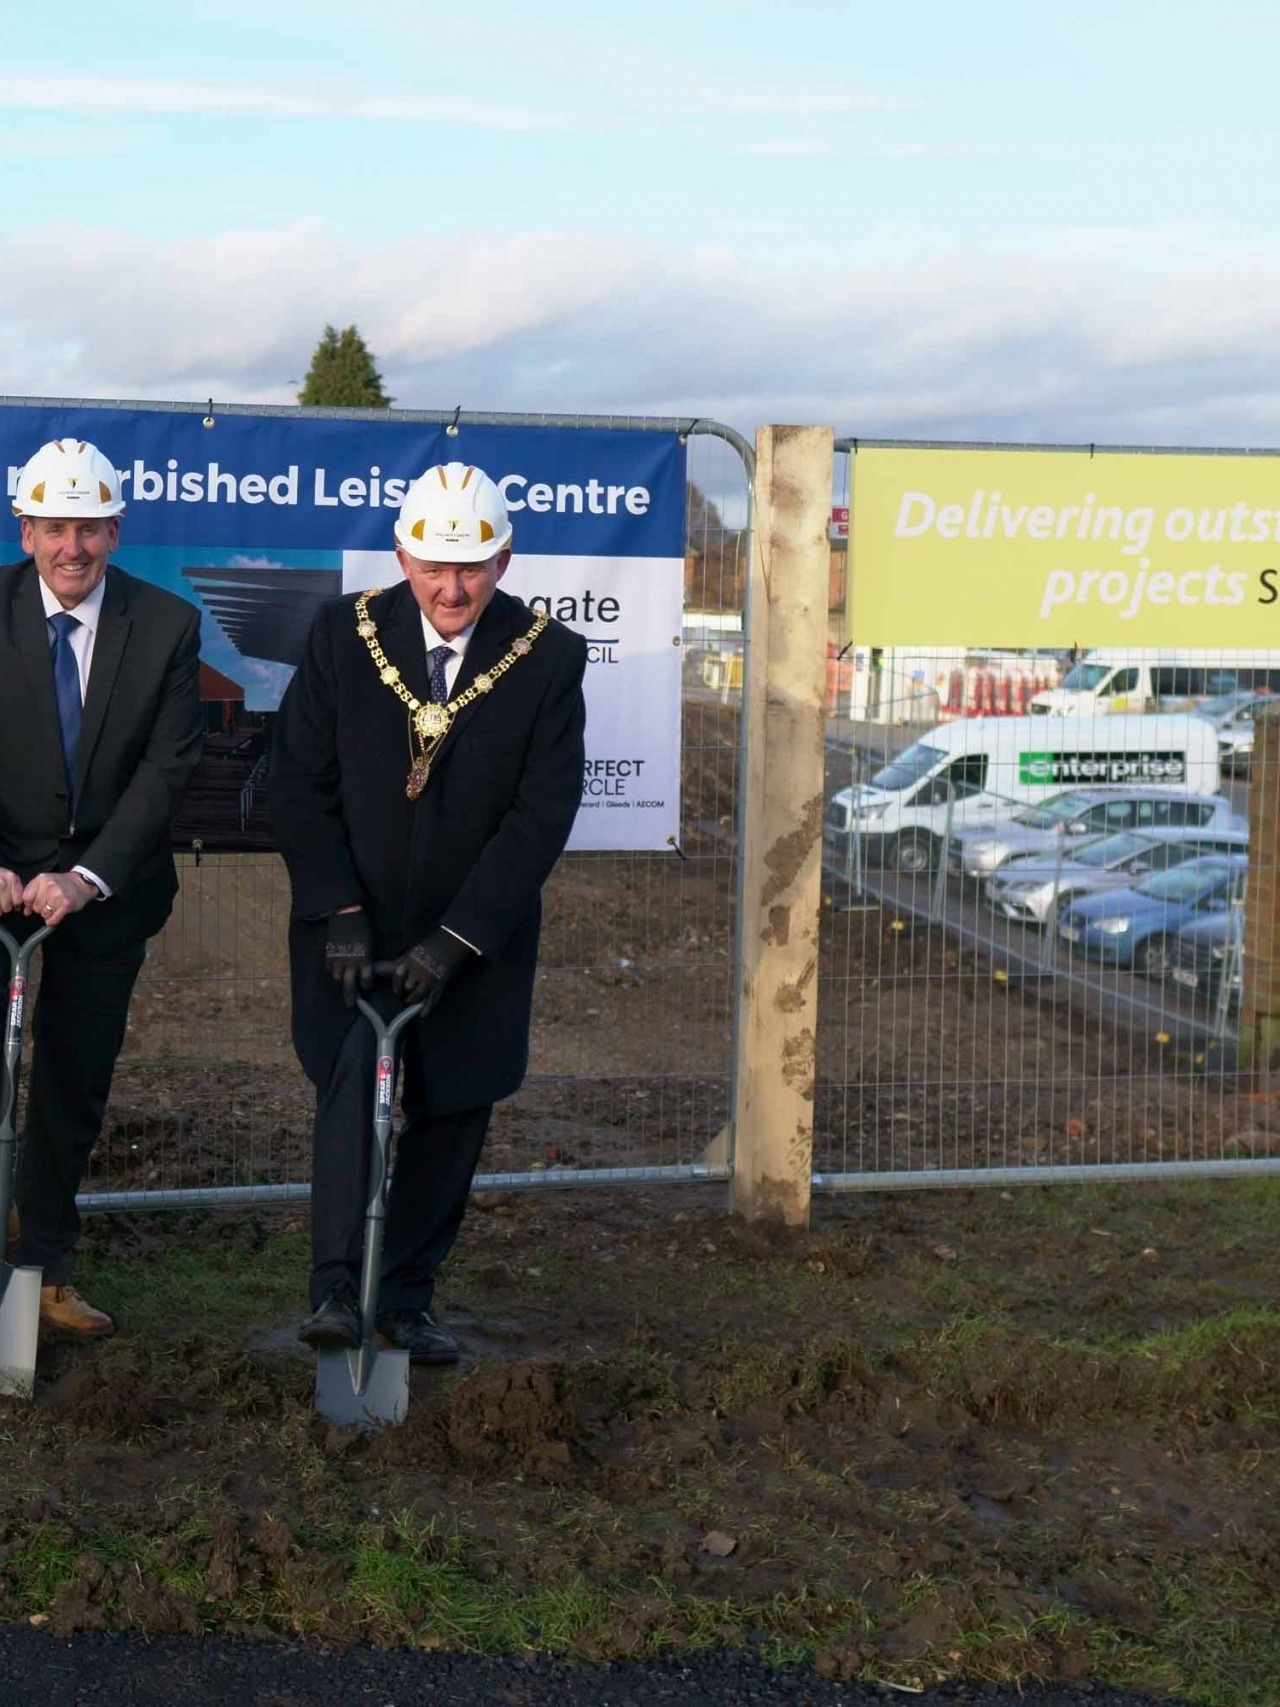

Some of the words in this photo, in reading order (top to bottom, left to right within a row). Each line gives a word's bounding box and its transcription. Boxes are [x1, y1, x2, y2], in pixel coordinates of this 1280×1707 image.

[314, 466, 420, 508] Leis
[497, 474, 651, 515] Centre
[894, 490, 1156, 555] Delivering
[1040, 557, 1247, 619] projects
[1258, 568, 1279, 604] S
[587, 646, 619, 663] CIL
[1029, 756, 1184, 780] enterprise
